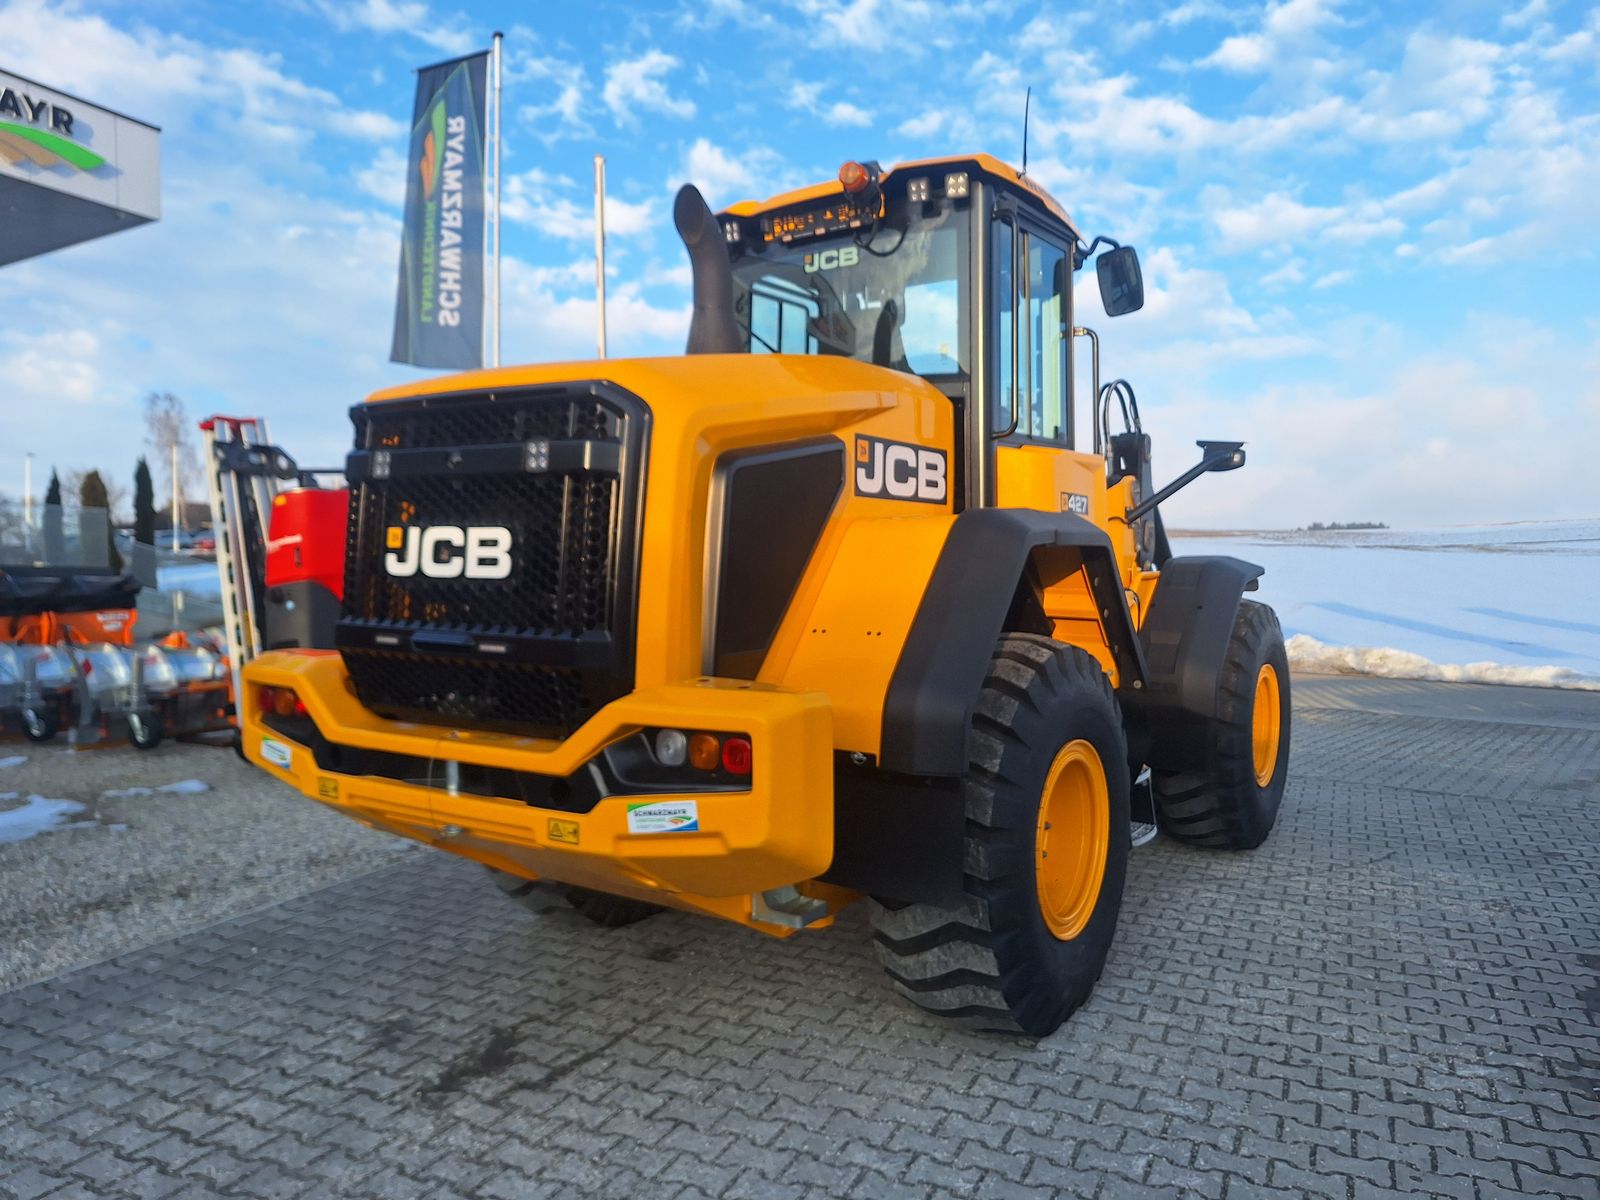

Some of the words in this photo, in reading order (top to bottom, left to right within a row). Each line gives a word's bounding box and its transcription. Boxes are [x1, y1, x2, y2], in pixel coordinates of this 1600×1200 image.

[804, 246, 859, 273] JCB
[857, 441, 946, 500] JCB
[1068, 495, 1088, 513] 427
[385, 525, 512, 579] JCB
